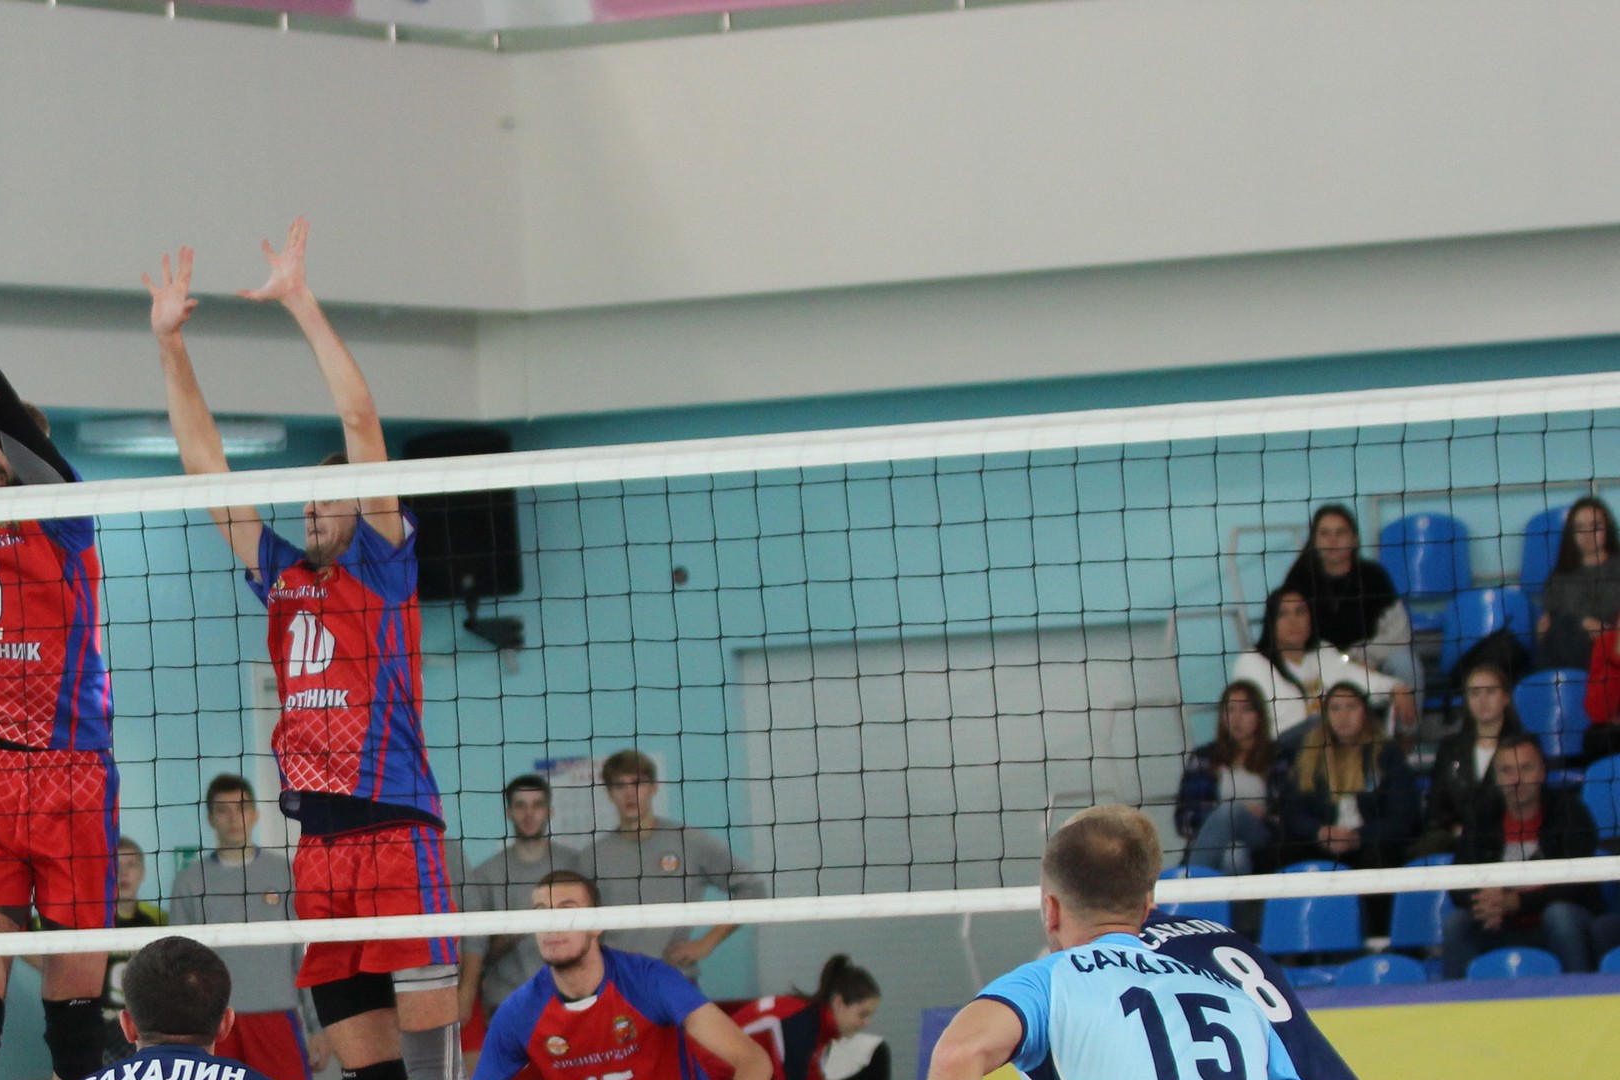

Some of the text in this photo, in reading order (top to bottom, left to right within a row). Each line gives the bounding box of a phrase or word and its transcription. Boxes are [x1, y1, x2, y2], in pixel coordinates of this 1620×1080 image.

[287, 610, 336, 678] 10
[1070, 949, 1236, 990] САХАЛИН
[1212, 946, 1293, 1023] 8
